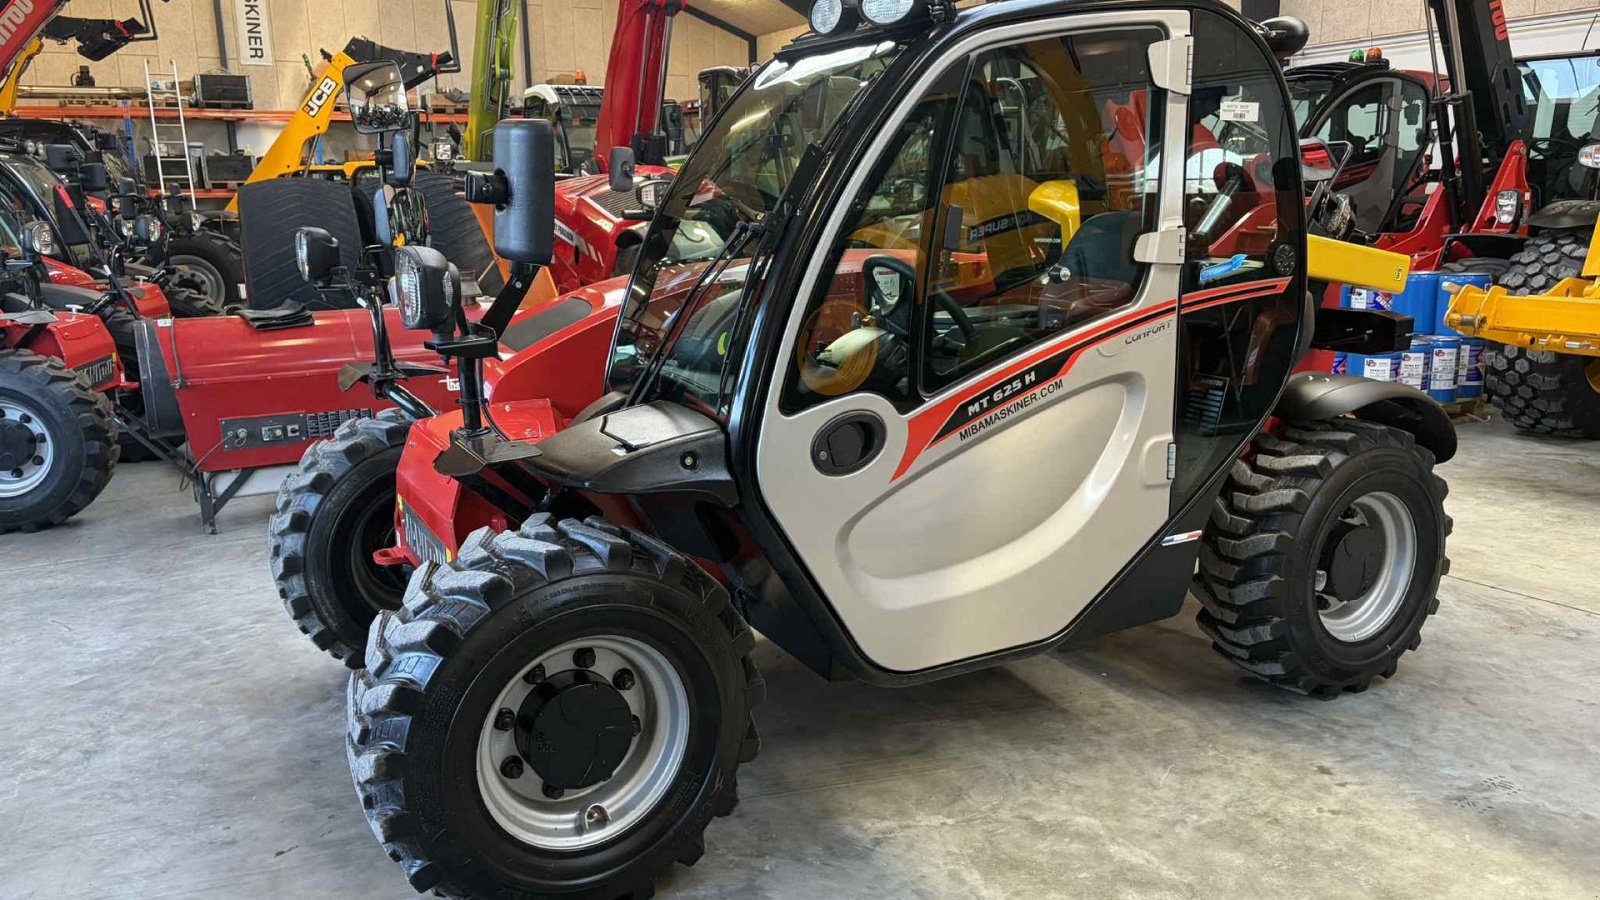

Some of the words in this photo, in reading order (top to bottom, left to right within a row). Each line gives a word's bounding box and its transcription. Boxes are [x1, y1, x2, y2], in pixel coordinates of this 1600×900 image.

[244, 0, 264, 59] KINER
[307, 77, 338, 117] JCB
[959, 378, 1064, 441] MIBAMASKINER.COM
[967, 396, 990, 416] MT
[992, 379, 1023, 402] 625
[1024, 370, 1037, 385] H
